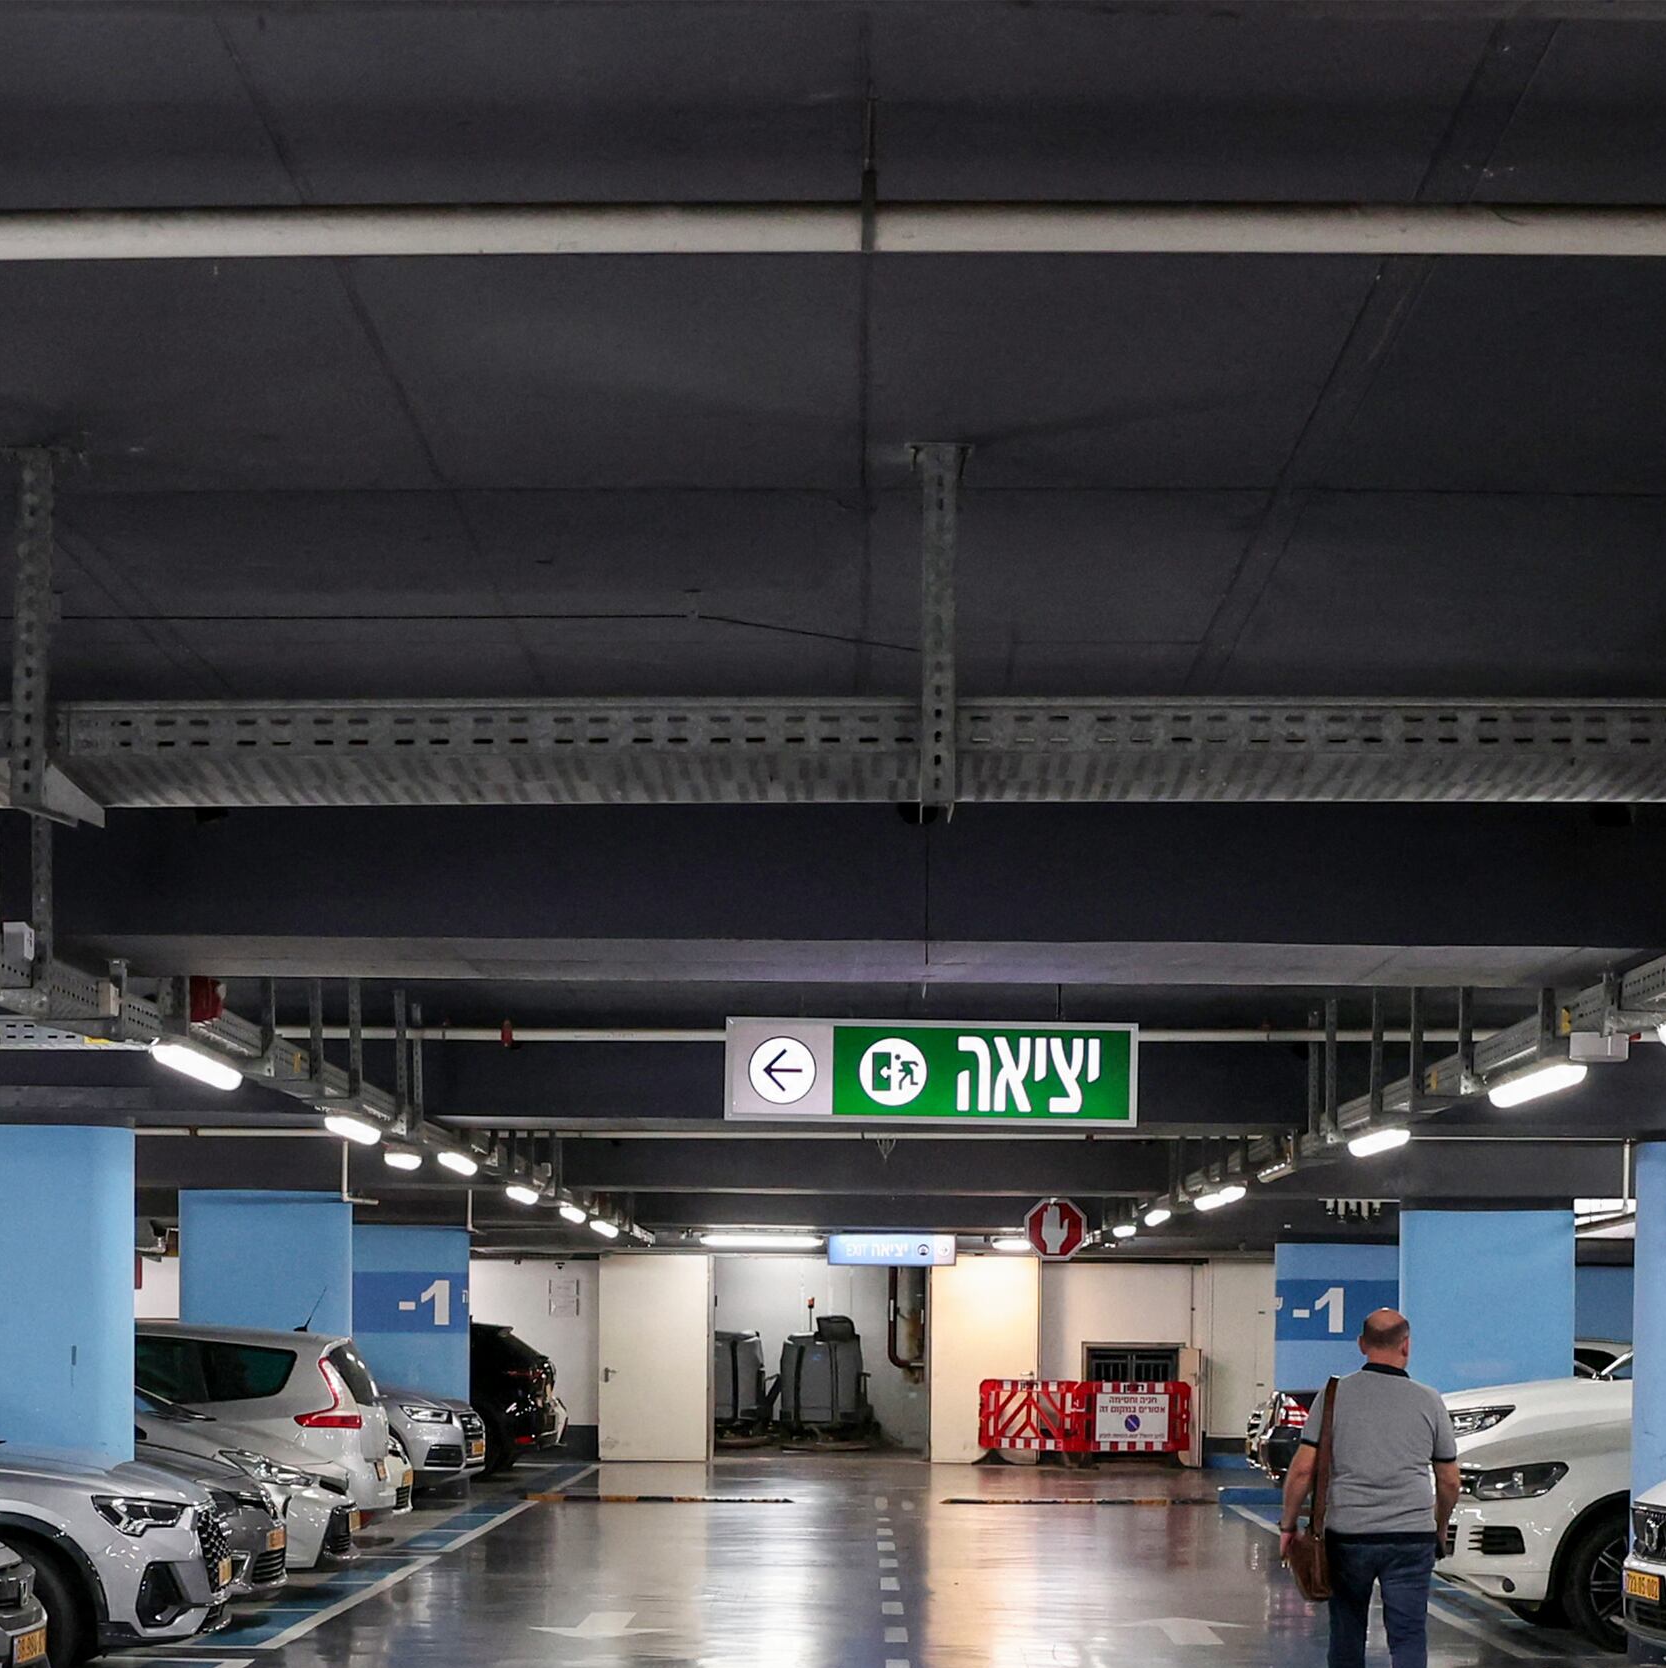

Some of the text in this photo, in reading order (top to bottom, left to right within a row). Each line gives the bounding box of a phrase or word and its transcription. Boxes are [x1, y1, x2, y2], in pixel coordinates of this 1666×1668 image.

[956, 1035, 1101, 1113] יציאה
[870, 1243, 909, 1257] יציאה
[398, 1280, 450, 1326] -1
[1293, 1287, 1344, 1333] -1
[1110, 1405, 1137, 1415] במקום
[1138, 1405, 1166, 1414] אסורים
